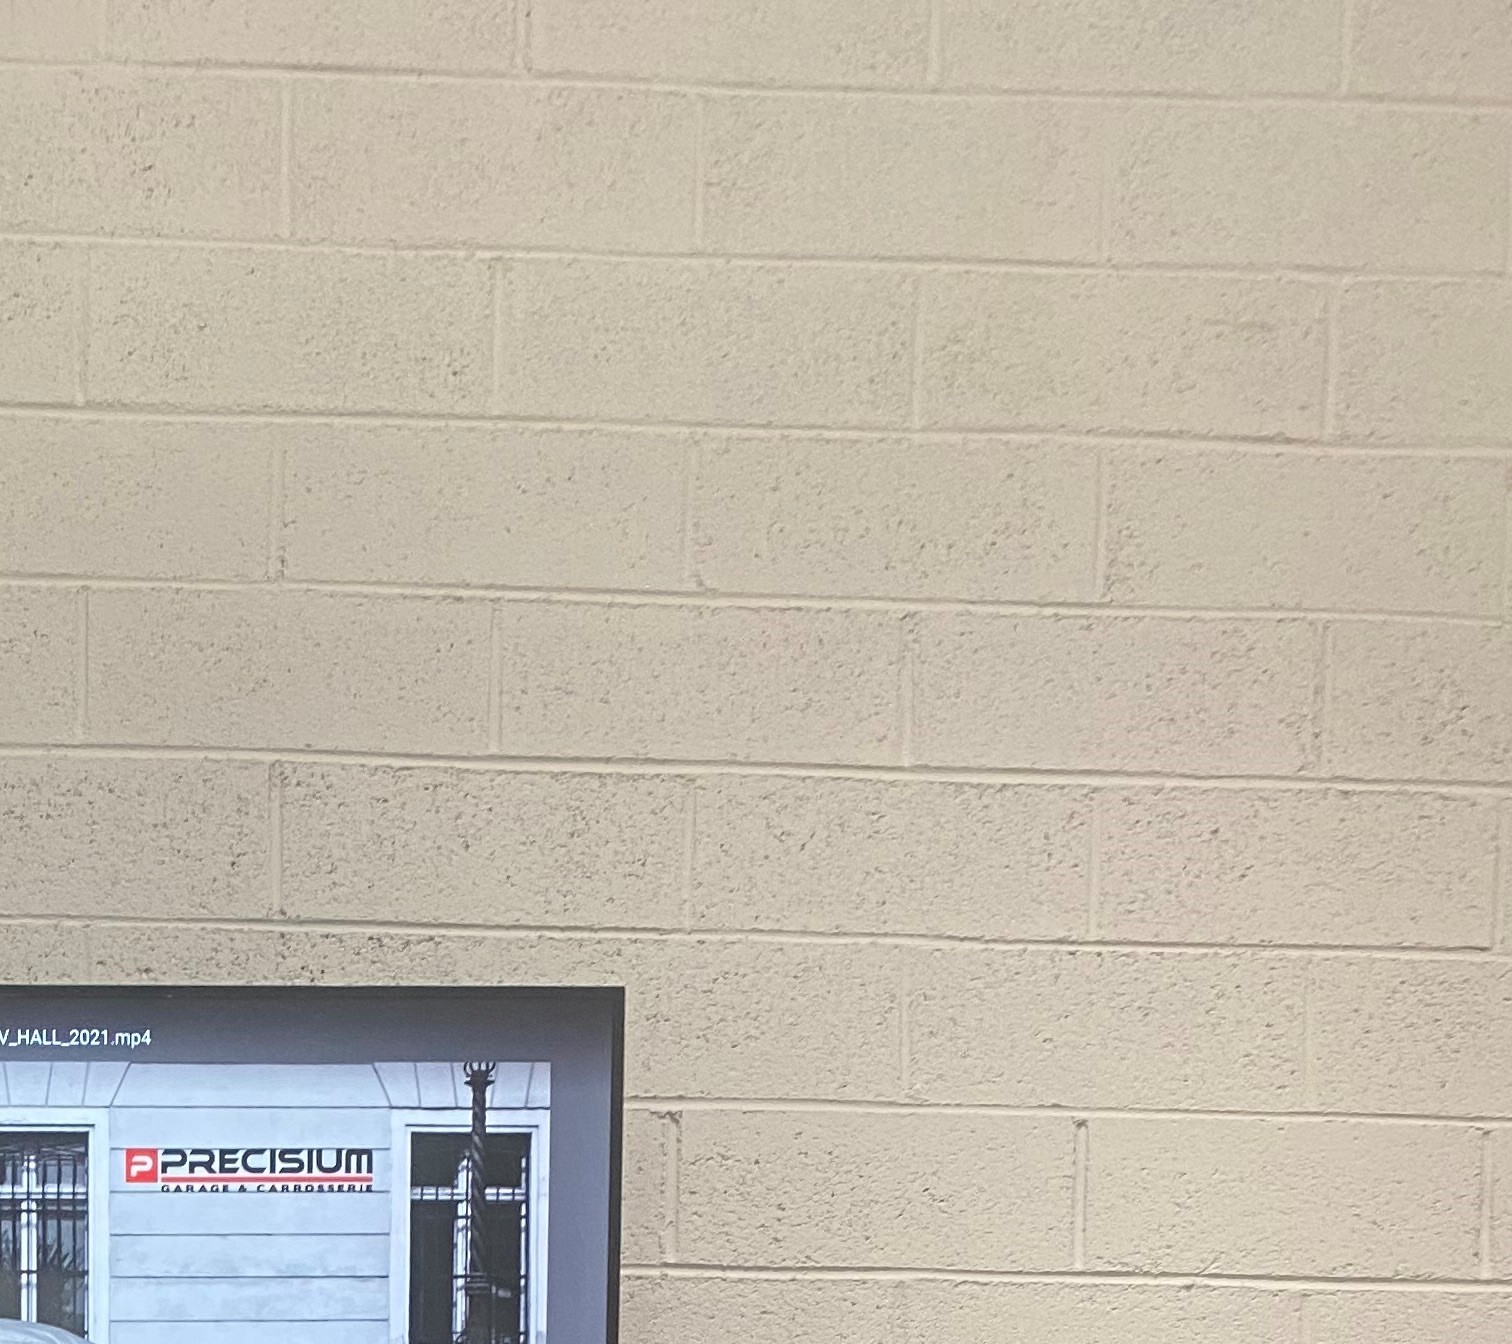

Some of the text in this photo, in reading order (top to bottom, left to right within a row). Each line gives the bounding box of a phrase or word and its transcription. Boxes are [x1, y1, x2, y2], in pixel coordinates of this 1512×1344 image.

[161, 1149, 374, 1174] PRECISIUM
[161, 1184, 374, 1193] GARAGE & CARROSSERIE
